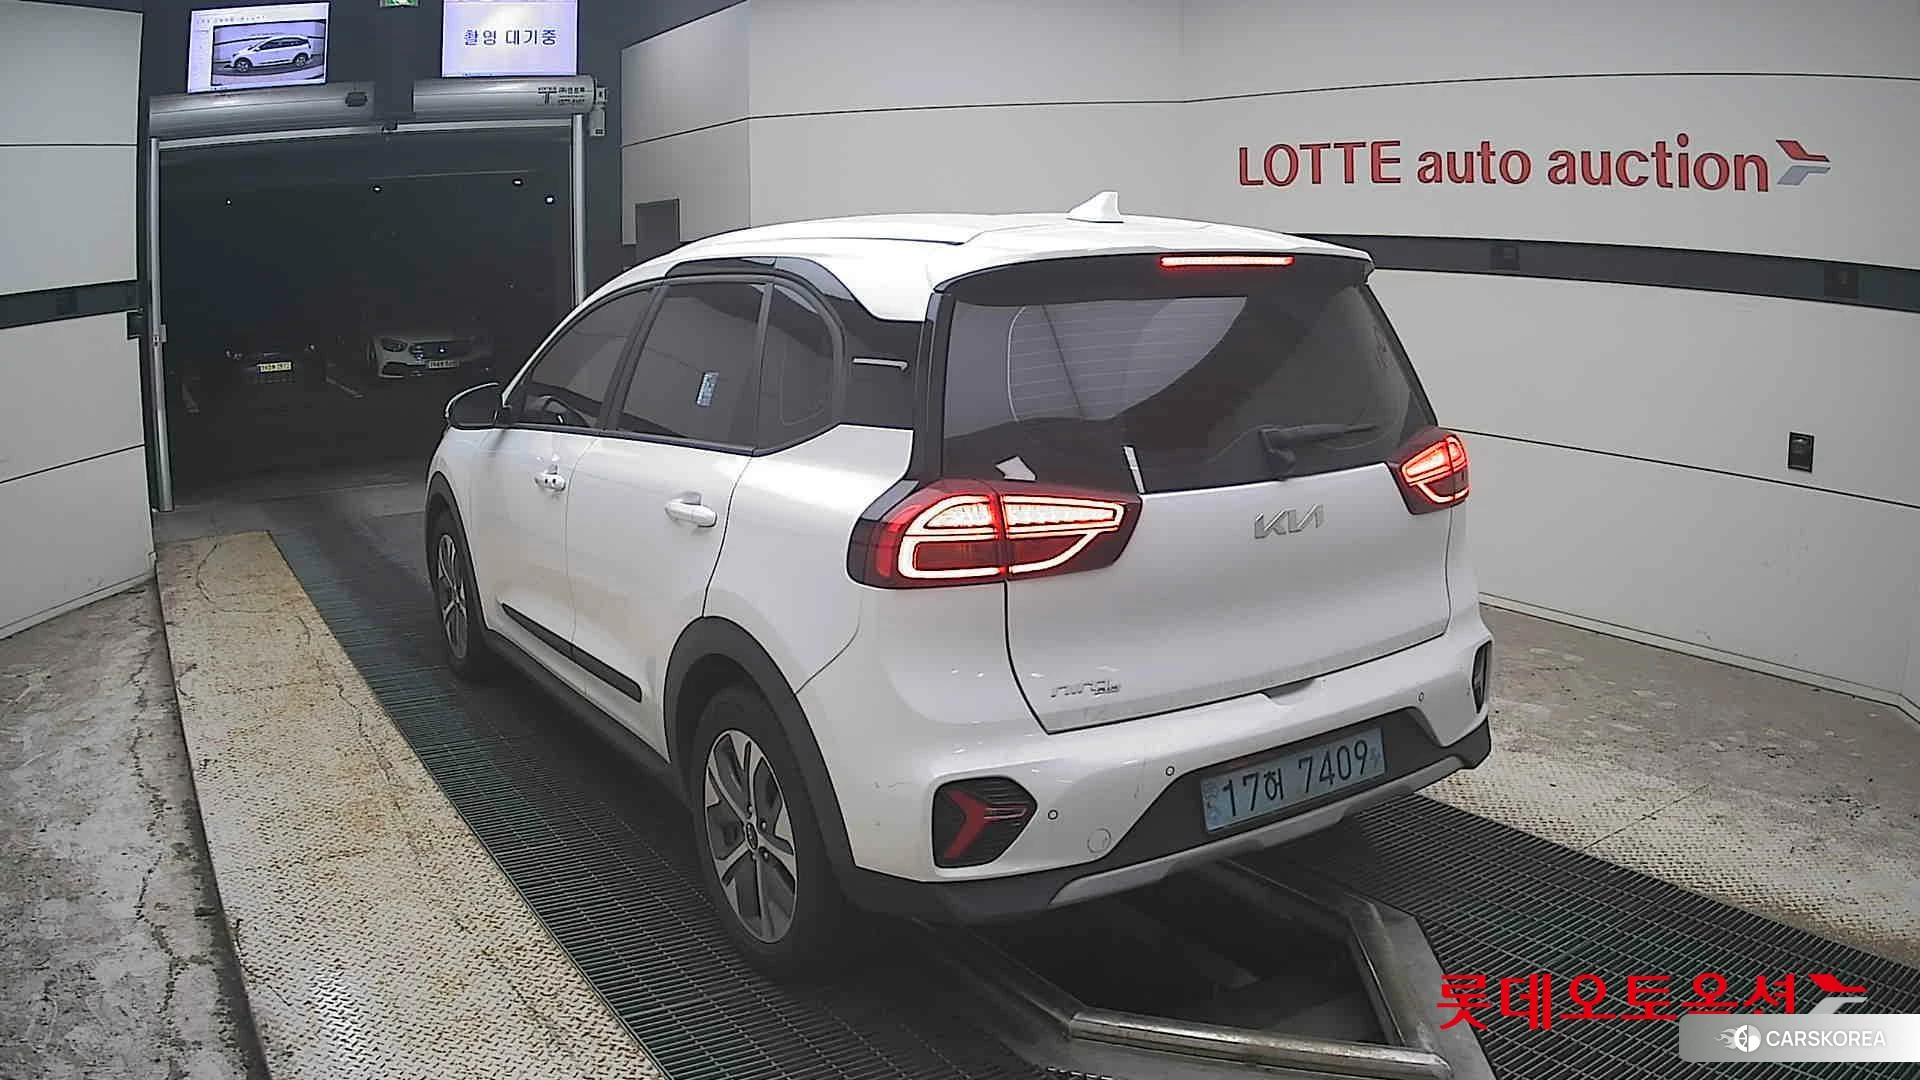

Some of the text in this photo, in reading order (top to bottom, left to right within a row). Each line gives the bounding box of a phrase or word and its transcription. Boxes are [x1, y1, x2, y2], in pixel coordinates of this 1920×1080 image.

[505, 29, 557, 46] 대기중
[1238, 132, 1770, 193] LOTTE auto auction
[1298, 739, 1369, 793] 7409
